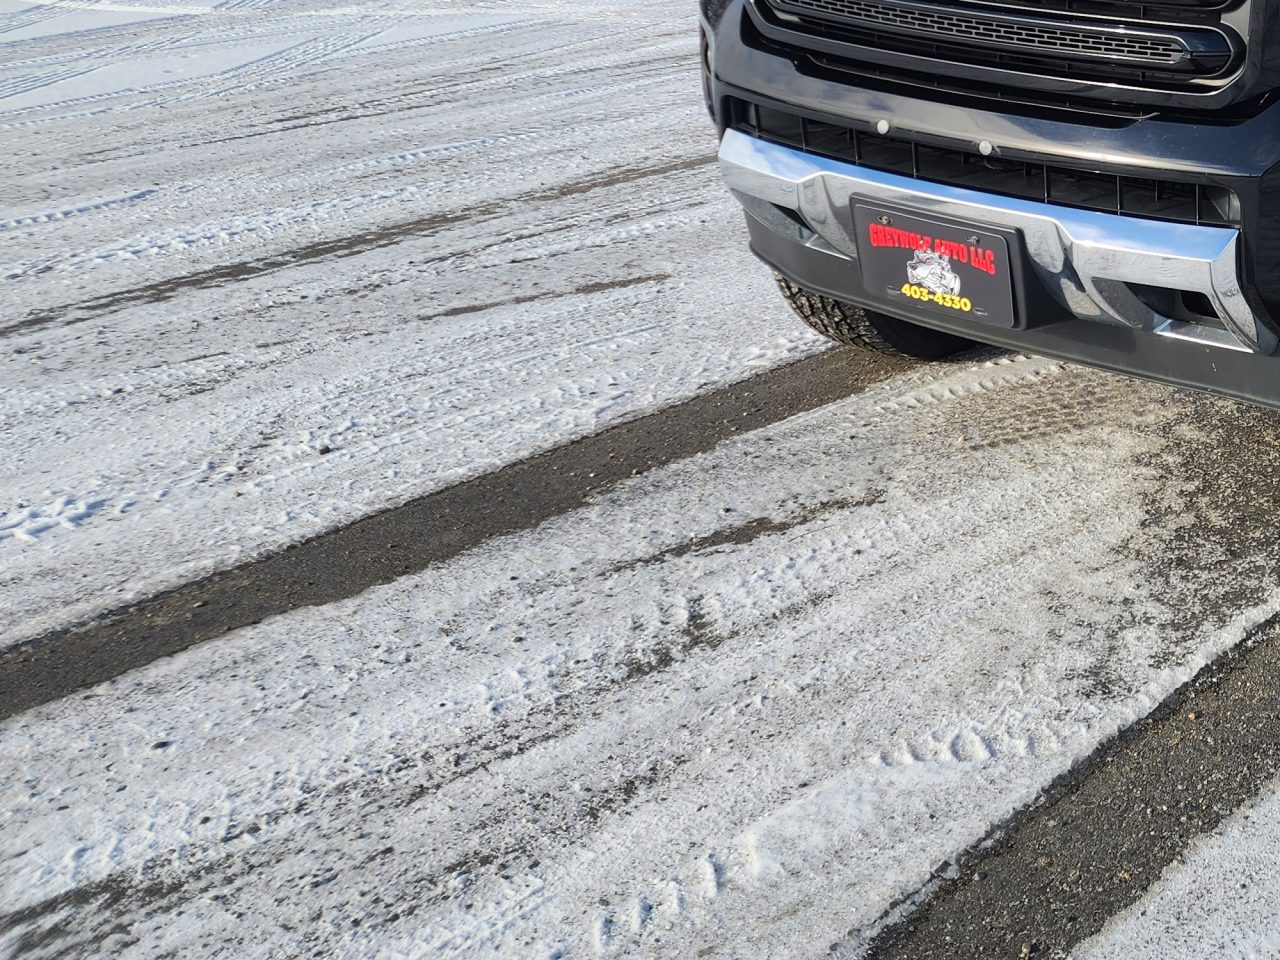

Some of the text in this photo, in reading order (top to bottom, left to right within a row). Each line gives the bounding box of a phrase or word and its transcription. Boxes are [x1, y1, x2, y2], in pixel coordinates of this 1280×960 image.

[868, 223, 997, 276] GREYWOLF AUTO LLC
[901, 283, 972, 312] 403-4330
